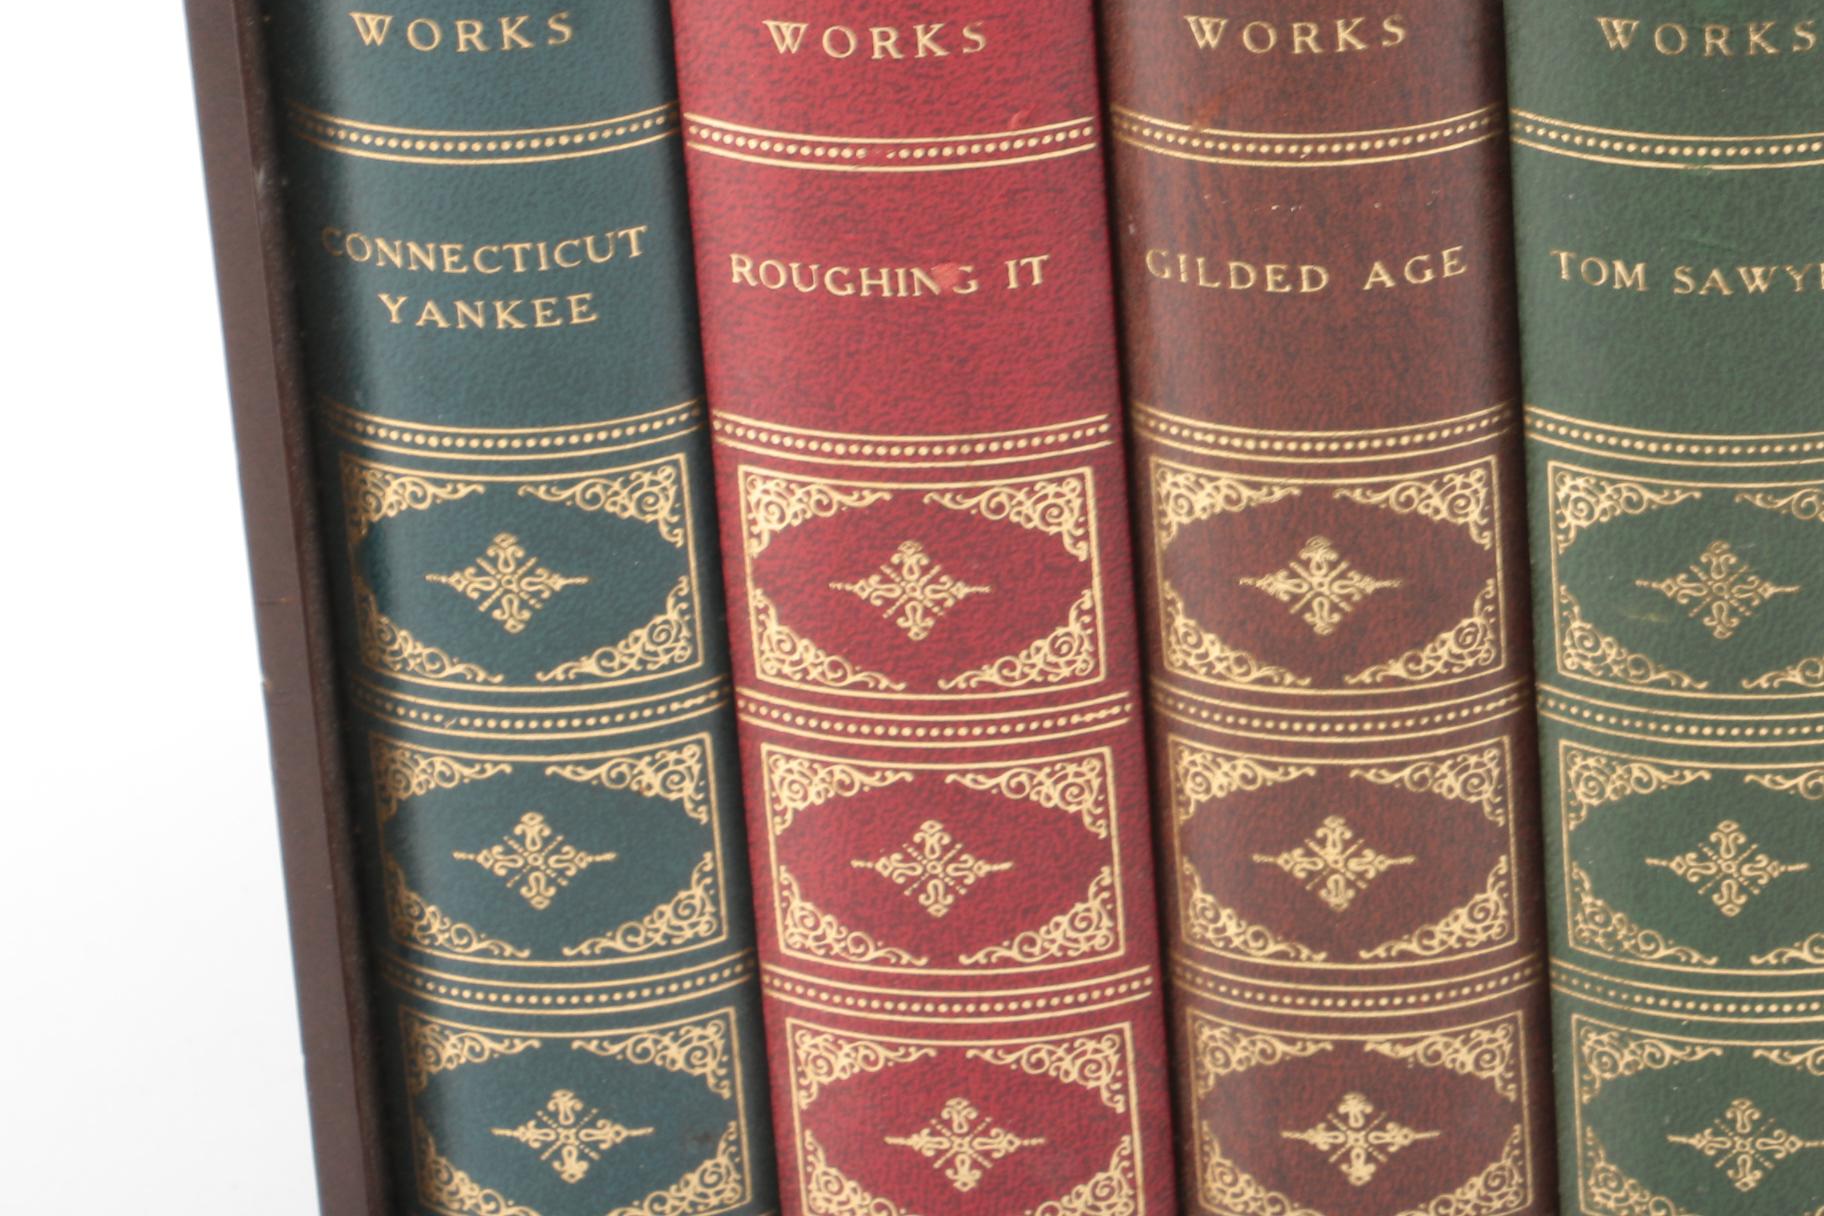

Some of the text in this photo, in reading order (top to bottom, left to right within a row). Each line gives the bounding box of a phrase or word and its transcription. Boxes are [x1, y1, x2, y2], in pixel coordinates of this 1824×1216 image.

[349, 12, 574, 52] WORKS
[763, 19, 988, 60] WORKS
[1185, 15, 1407, 54] WORKS
[1597, 18, 1817, 57] WORKS
[322, 224, 647, 273] CONNECTICUT
[1005, 254, 1049, 290] IT
[1145, 246, 1467, 293] GILDED AGE
[1550, 250, 1648, 291] TOM
[378, 293, 598, 330] YANKEE
